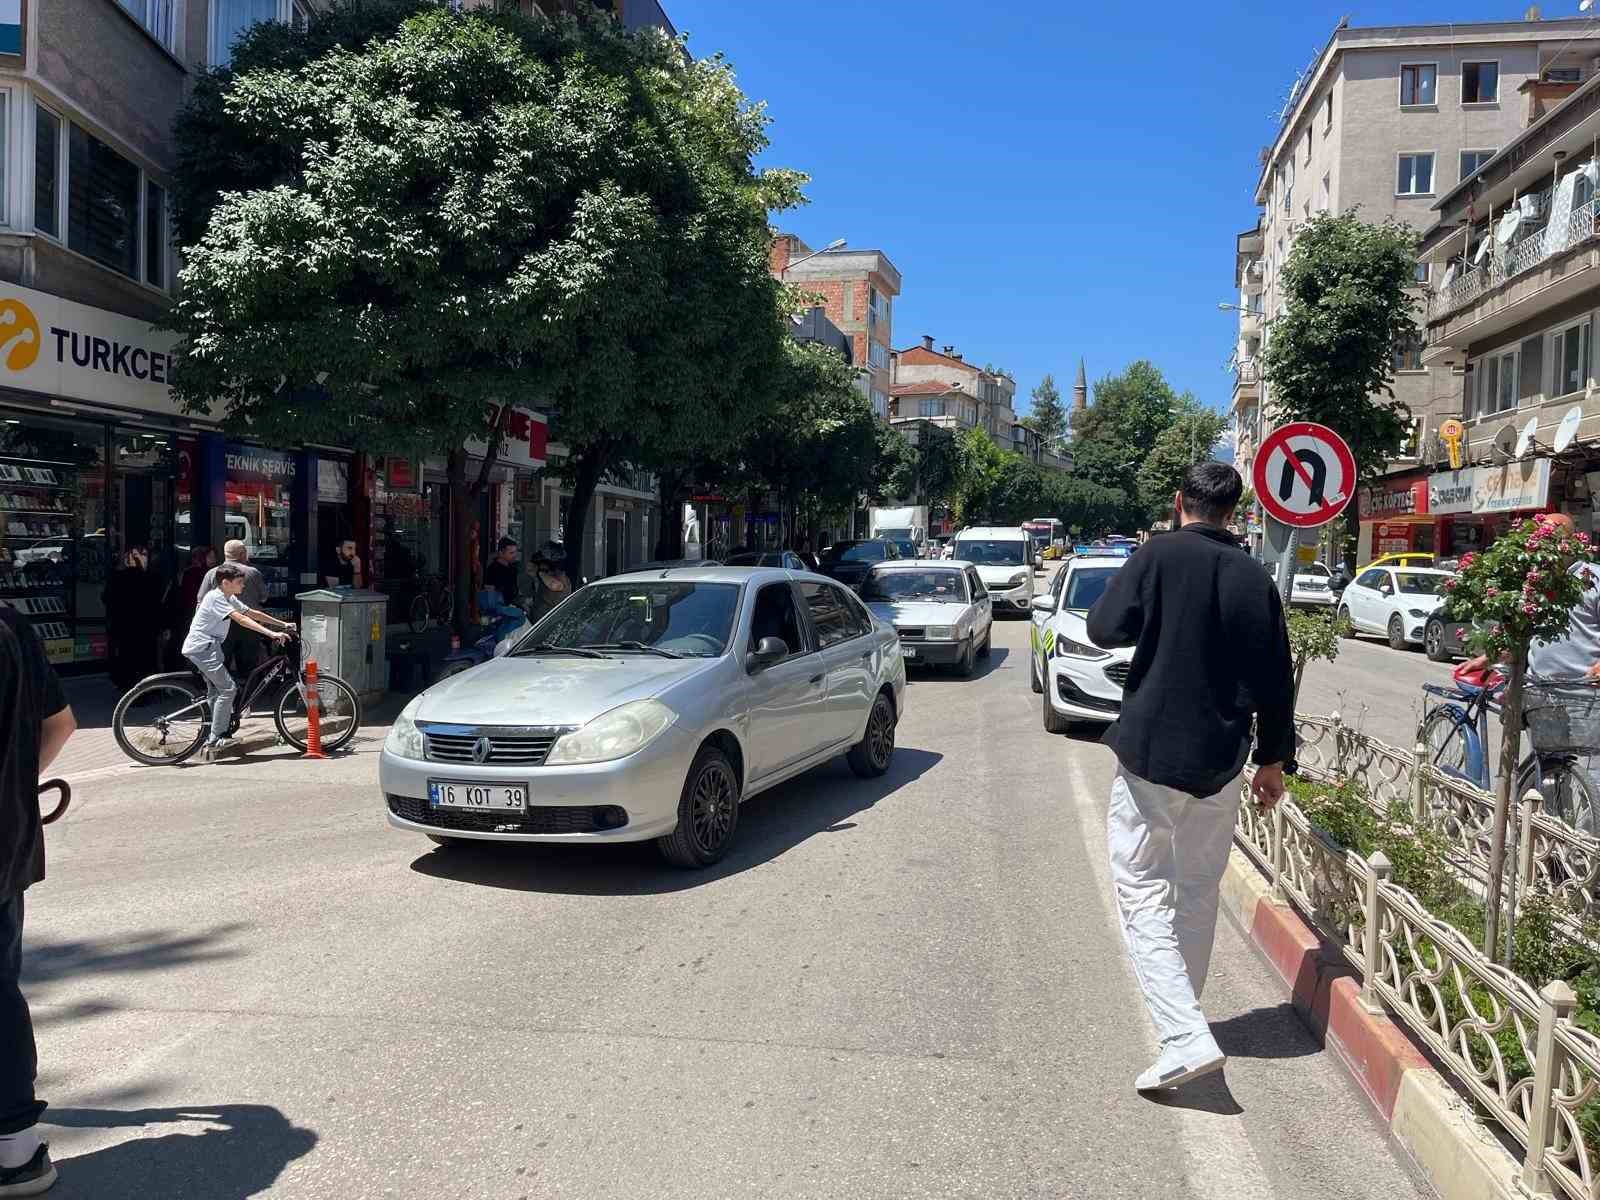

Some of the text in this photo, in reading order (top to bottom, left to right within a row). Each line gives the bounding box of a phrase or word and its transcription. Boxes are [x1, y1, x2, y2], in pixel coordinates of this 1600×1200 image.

[50, 327, 177, 386] TURKCEL
[440, 786, 455, 804] 16
[466, 787, 491, 806] KOT
[504, 789, 522, 807] 39
